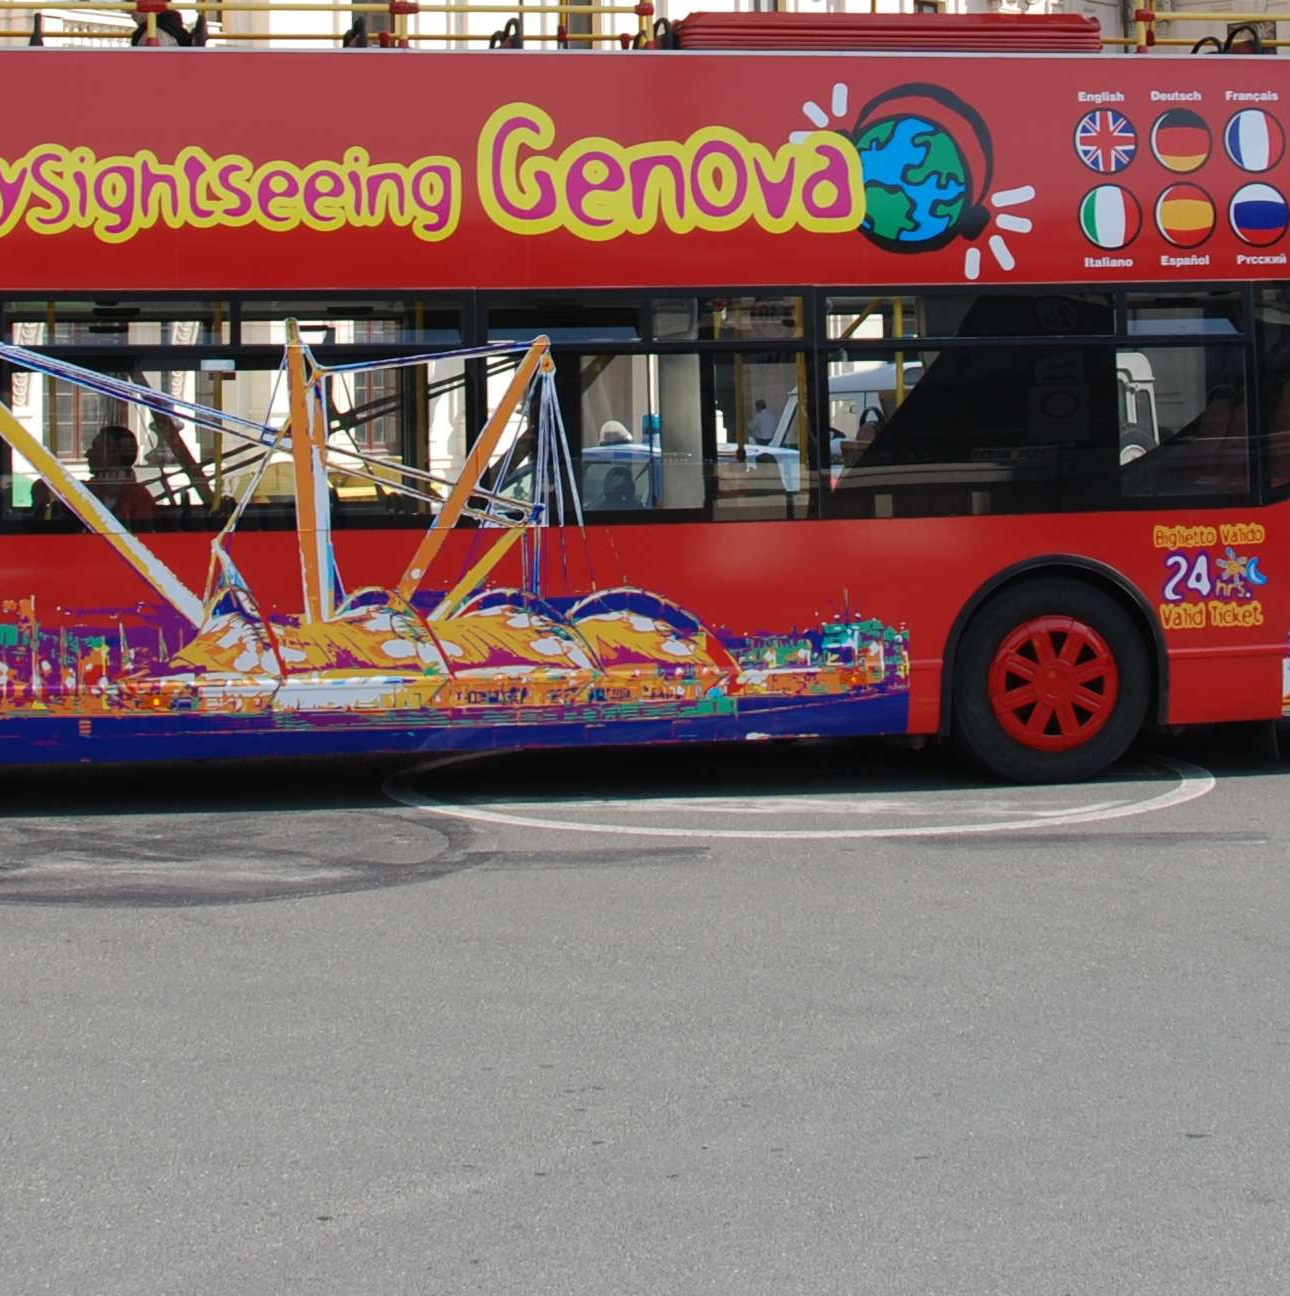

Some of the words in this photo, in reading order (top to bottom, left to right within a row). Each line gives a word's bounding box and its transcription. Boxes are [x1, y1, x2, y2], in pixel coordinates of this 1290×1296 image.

[1077, 91, 1125, 103] English
[1150, 90, 1202, 101] Deutsch
[1225, 90, 1279, 102] Français
[478, 103, 865, 241] Genova
[1084, 257, 1133, 267] Italiano
[1161, 255, 1210, 267] Español
[1155, 527, 1216, 550] Biglietto
[1220, 524, 1265, 545] Valido
[1164, 554, 1211, 601] 24
[1215, 579, 1252, 598] hrs.
[1161, 604, 1205, 628] Valid
[1209, 601, 1262, 626] Ticket
